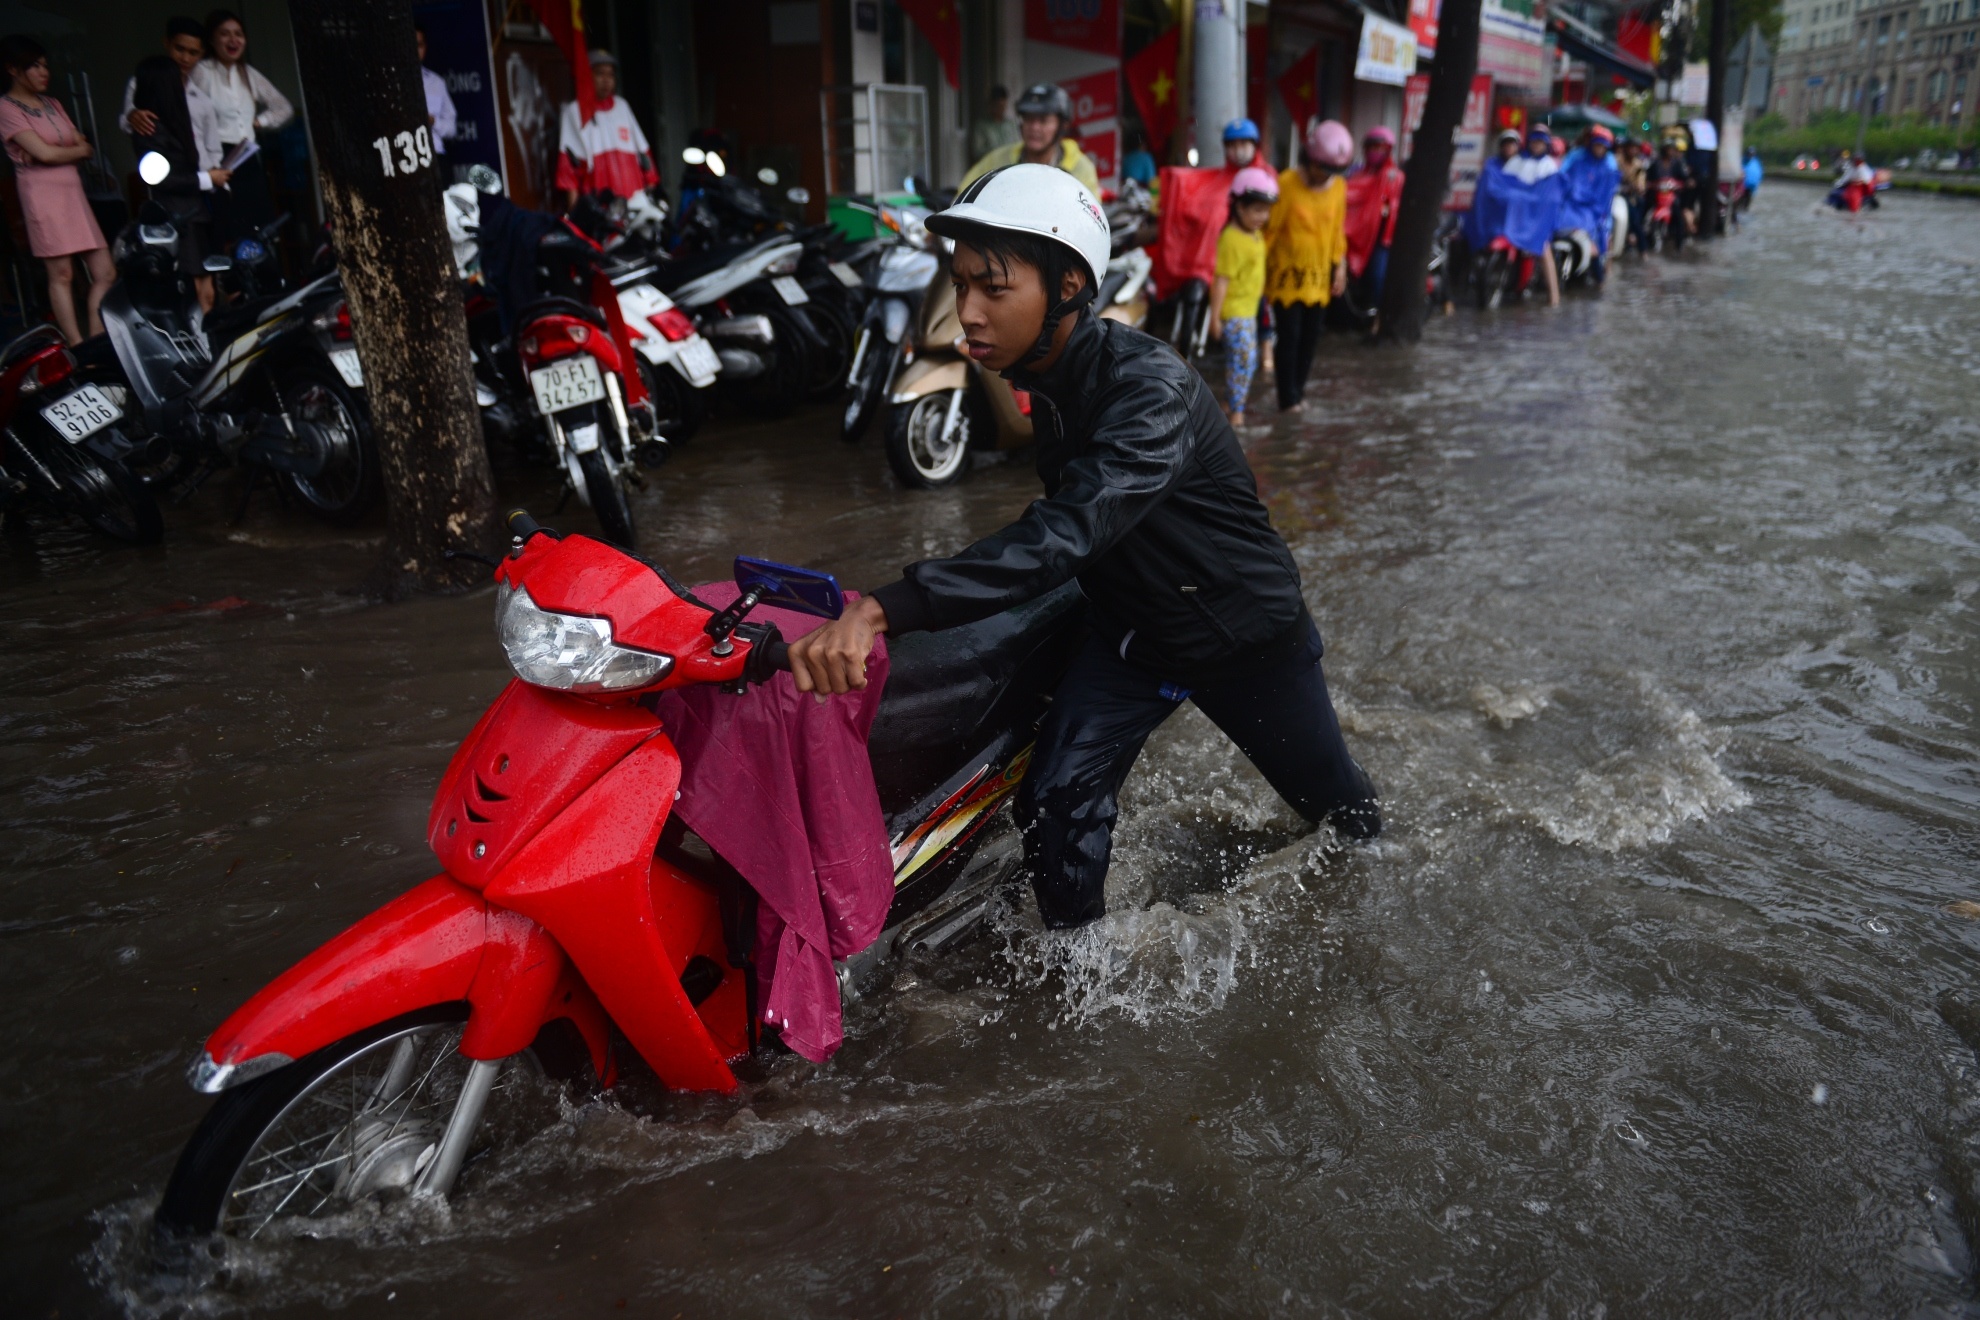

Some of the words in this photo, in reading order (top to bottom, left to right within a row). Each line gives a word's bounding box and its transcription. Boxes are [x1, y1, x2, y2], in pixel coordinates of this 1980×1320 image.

[445, 67, 482, 93] ÒNG
[455, 119, 479, 142] CH
[372, 124, 433, 178] 139
[542, 361, 587, 389] 70-F1
[50, 390, 98, 421] 52-Y4
[541, 379, 597, 411] 342.57
[66, 404, 113, 436] 9706
